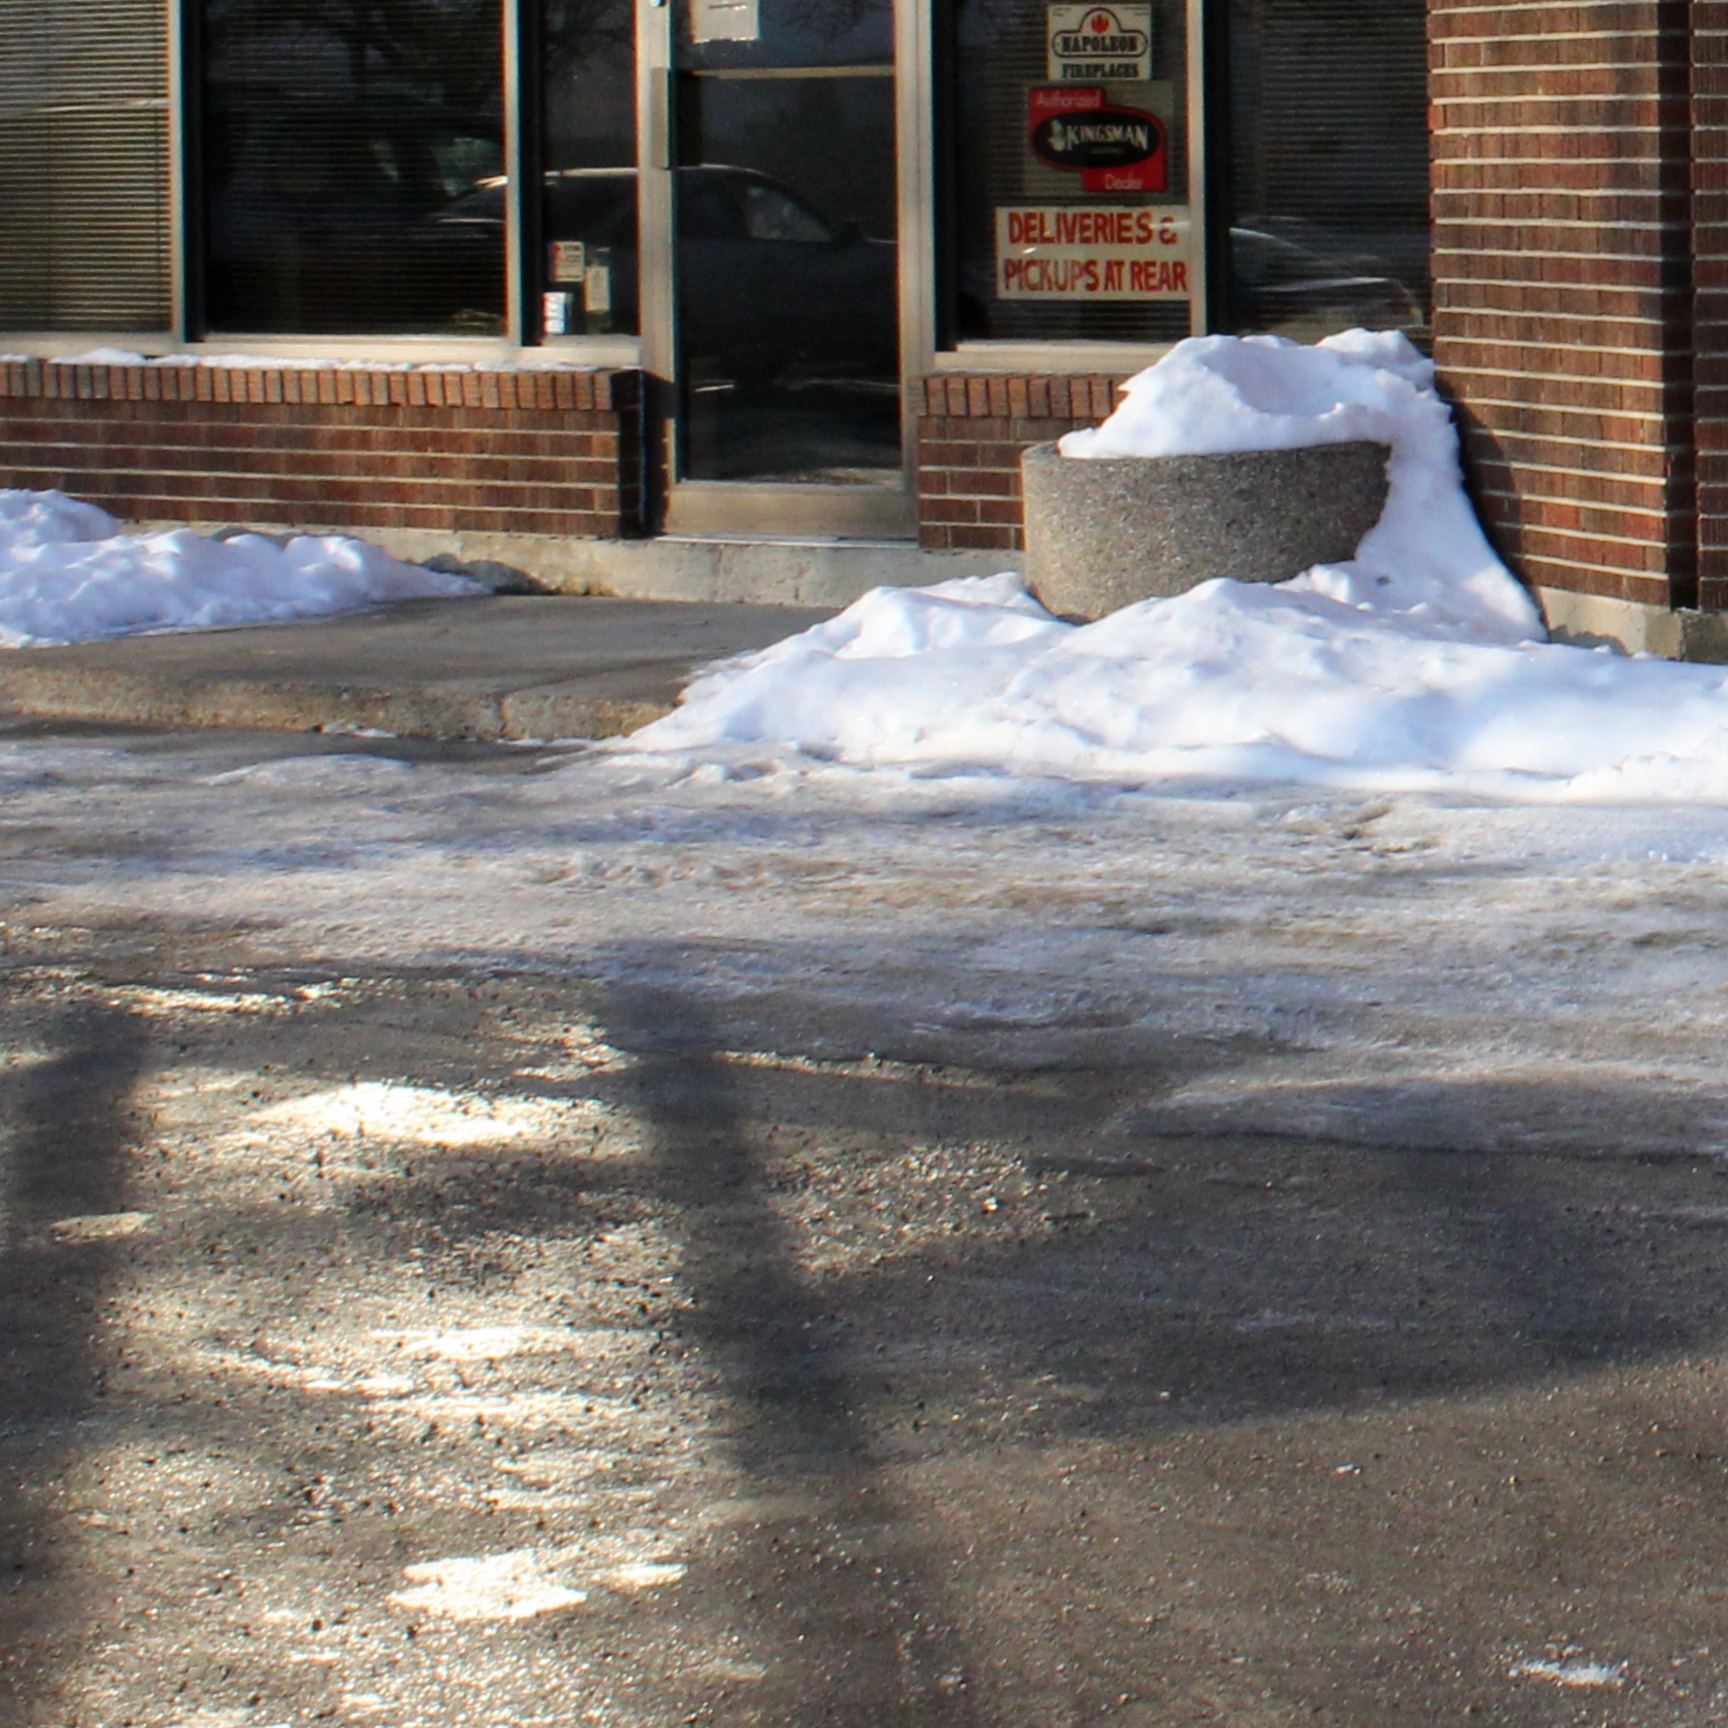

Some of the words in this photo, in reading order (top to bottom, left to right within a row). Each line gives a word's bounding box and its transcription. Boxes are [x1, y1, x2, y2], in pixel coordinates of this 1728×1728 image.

[1061, 35, 1139, 52] NAPOLEON
[1066, 124, 1149, 151] KINGSMAN
[1008, 211, 1154, 245] DELIVERIES
[1159, 216, 1178, 245] &
[1003, 258, 1100, 292] PICKUPS
[1103, 259, 1126, 292] AT
[1130, 260, 1188, 292] REAR
